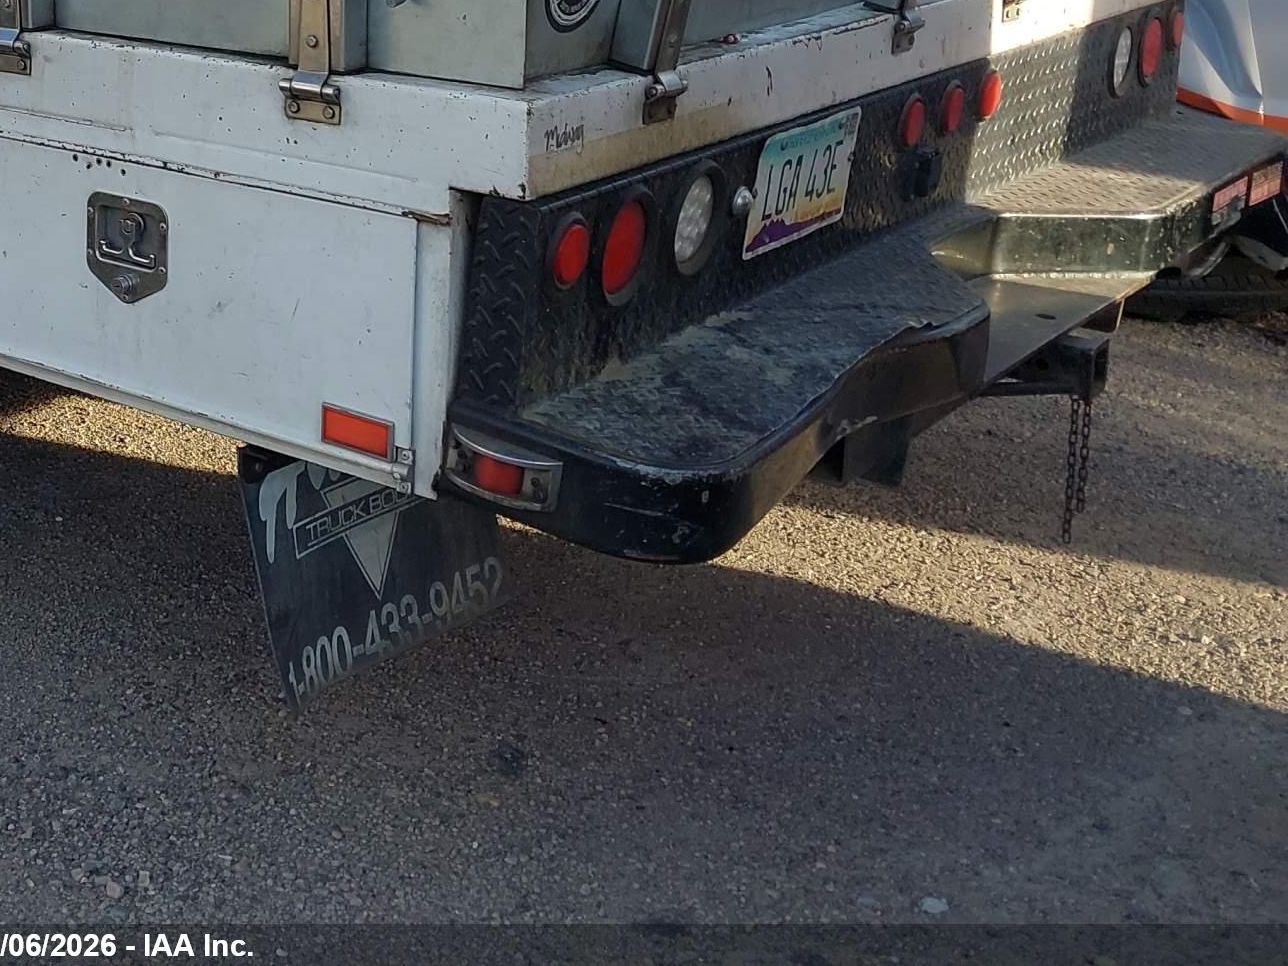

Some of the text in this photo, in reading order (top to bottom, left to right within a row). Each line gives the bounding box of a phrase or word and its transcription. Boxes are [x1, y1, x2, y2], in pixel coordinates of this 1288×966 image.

[761, 154, 804, 221] LGA
[306, 487, 413, 541] TRUCK BOD
[288, 556, 504, 708] 1-800-433-9452
